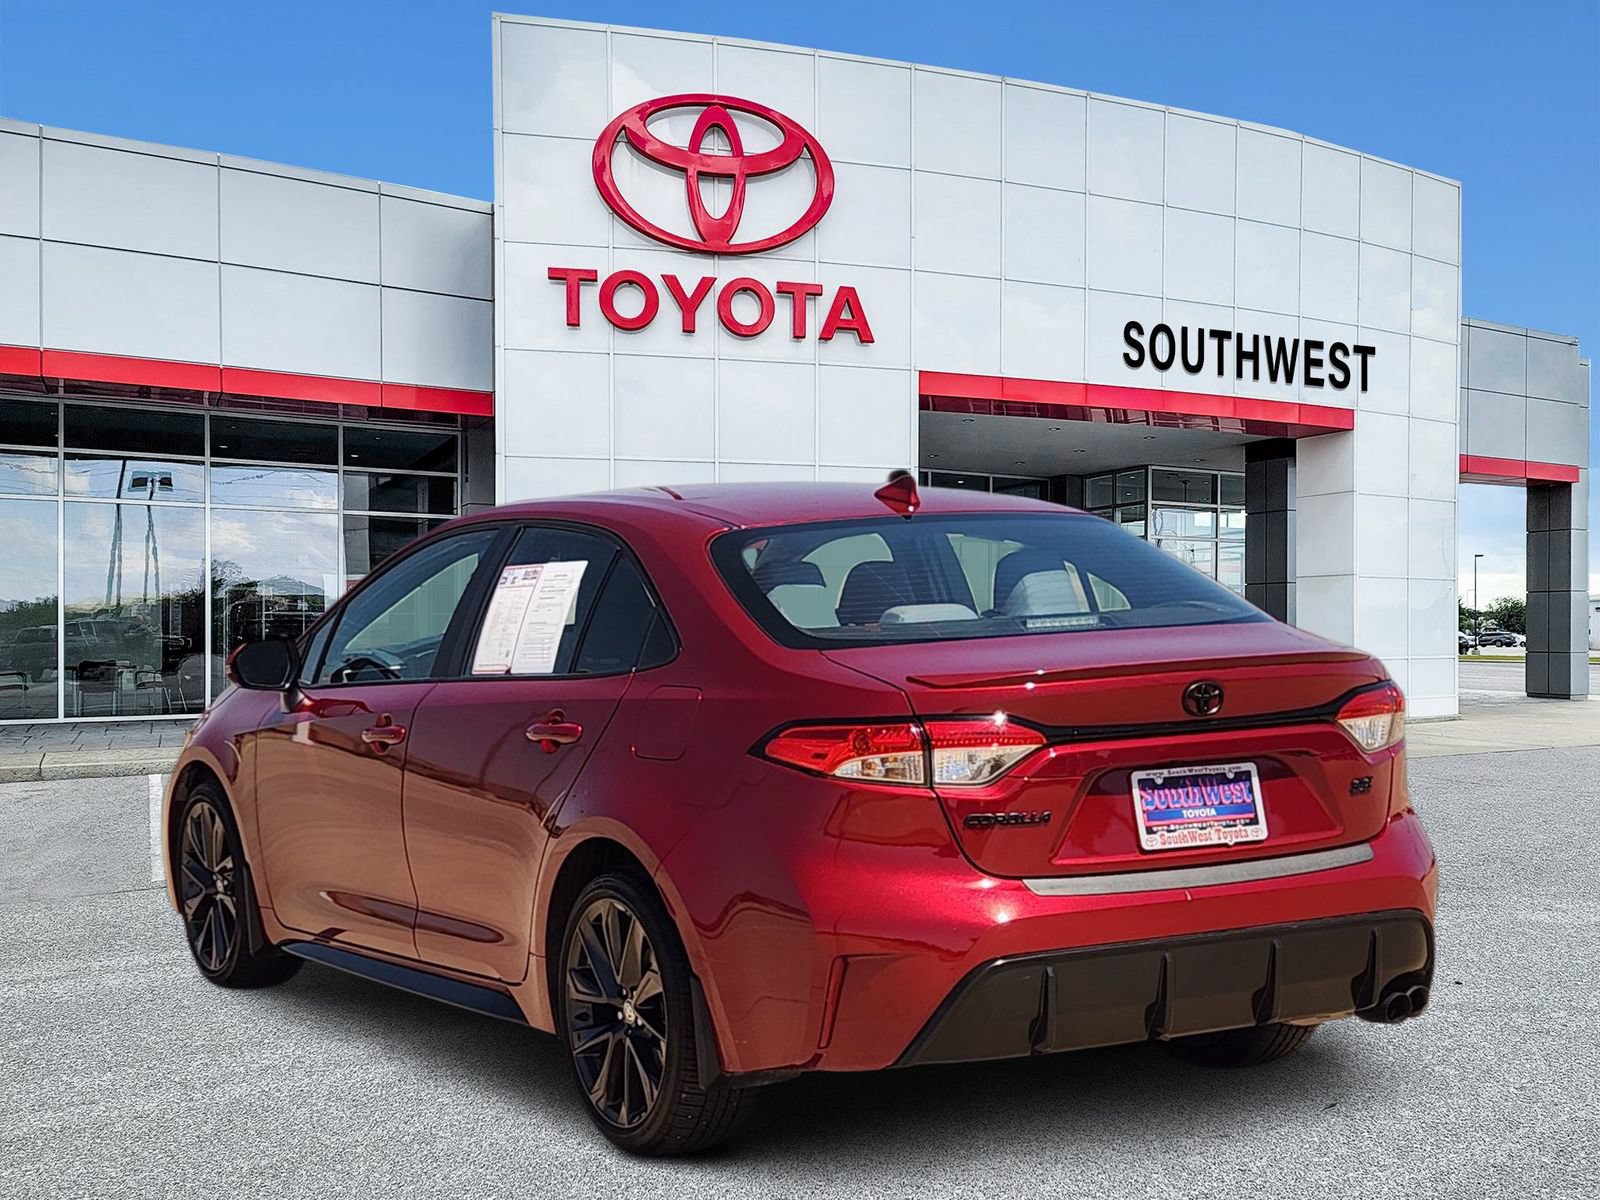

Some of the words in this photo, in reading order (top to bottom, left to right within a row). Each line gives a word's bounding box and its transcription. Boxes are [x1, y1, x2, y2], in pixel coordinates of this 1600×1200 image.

[547, 266, 875, 344] TOYOTA
[1122, 320, 1376, 393] SOUTHWEST
[963, 811, 1052, 830] COROLLA
[1181, 807, 1217, 819] TOYOTA
[1160, 829, 1213, 846] SouthWest
[1214, 827, 1249, 844] Toyota
